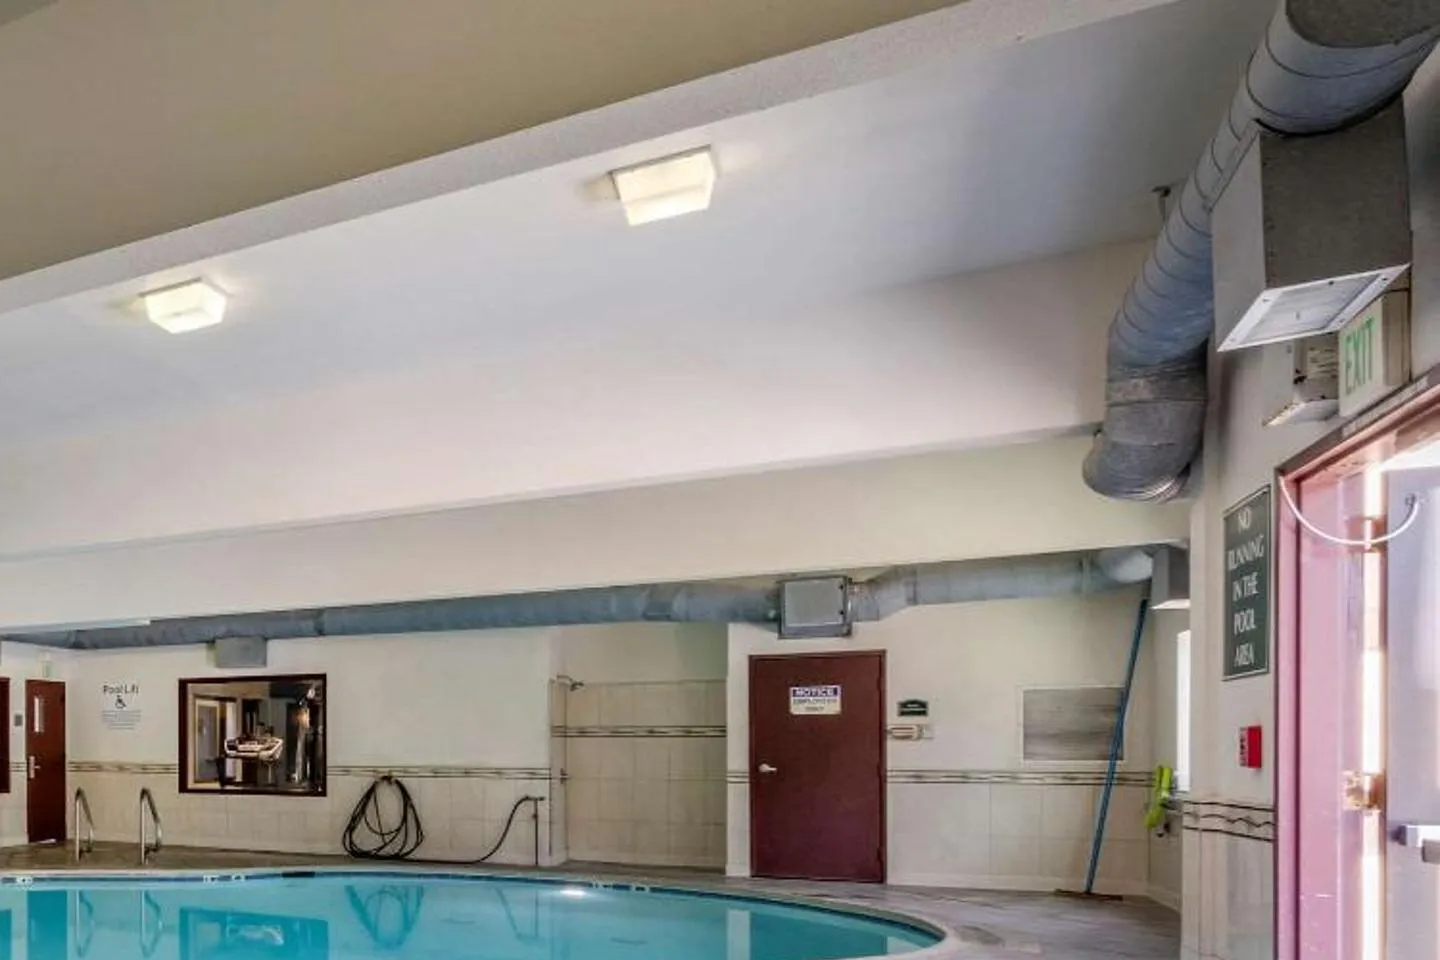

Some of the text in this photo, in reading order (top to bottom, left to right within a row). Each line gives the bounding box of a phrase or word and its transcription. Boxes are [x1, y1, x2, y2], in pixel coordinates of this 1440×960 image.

[1344, 316, 1375, 396] EXIT
[1238, 508, 1251, 533] NO
[1228, 534, 1264, 571] RUNNING
[1233, 571, 1259, 601] IN THE
[1234, 608, 1256, 635] POOL
[1234, 642, 1255, 667] AREA
[103, 684, 123, 695] Pool
[795, 686, 834, 697] NOTICE
